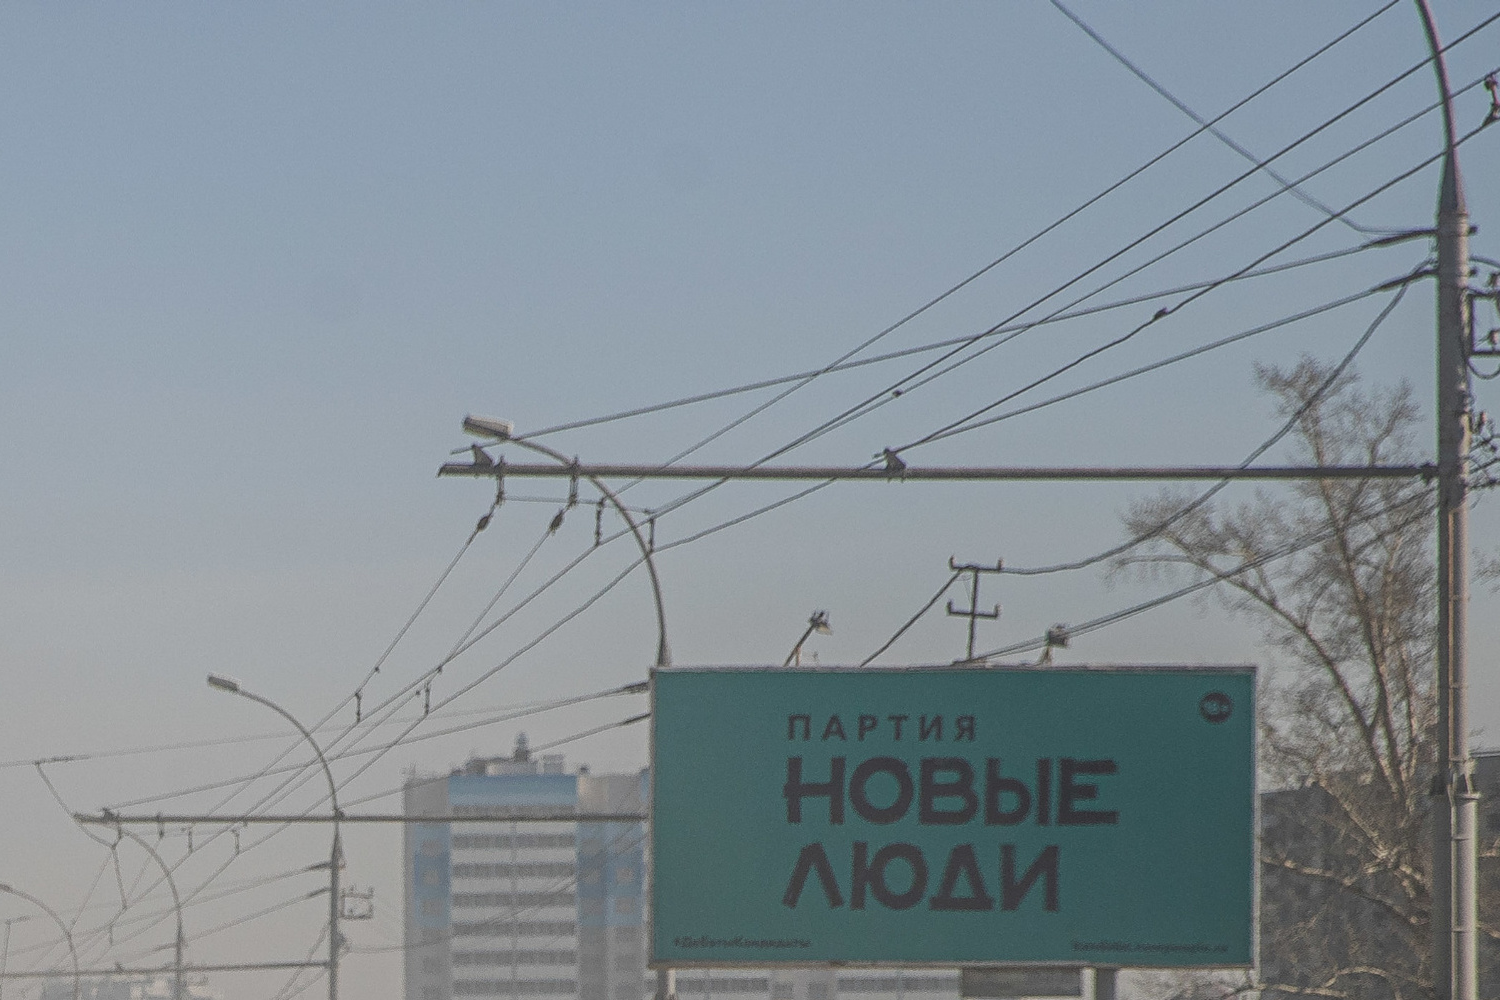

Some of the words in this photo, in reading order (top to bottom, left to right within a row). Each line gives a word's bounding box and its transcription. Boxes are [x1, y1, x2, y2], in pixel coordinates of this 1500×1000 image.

[787, 713, 977, 743] ПАРТИЯ
[783, 756, 1120, 826] НОВЫЕ
[782, 841, 1060, 914] ЛЮДИ
